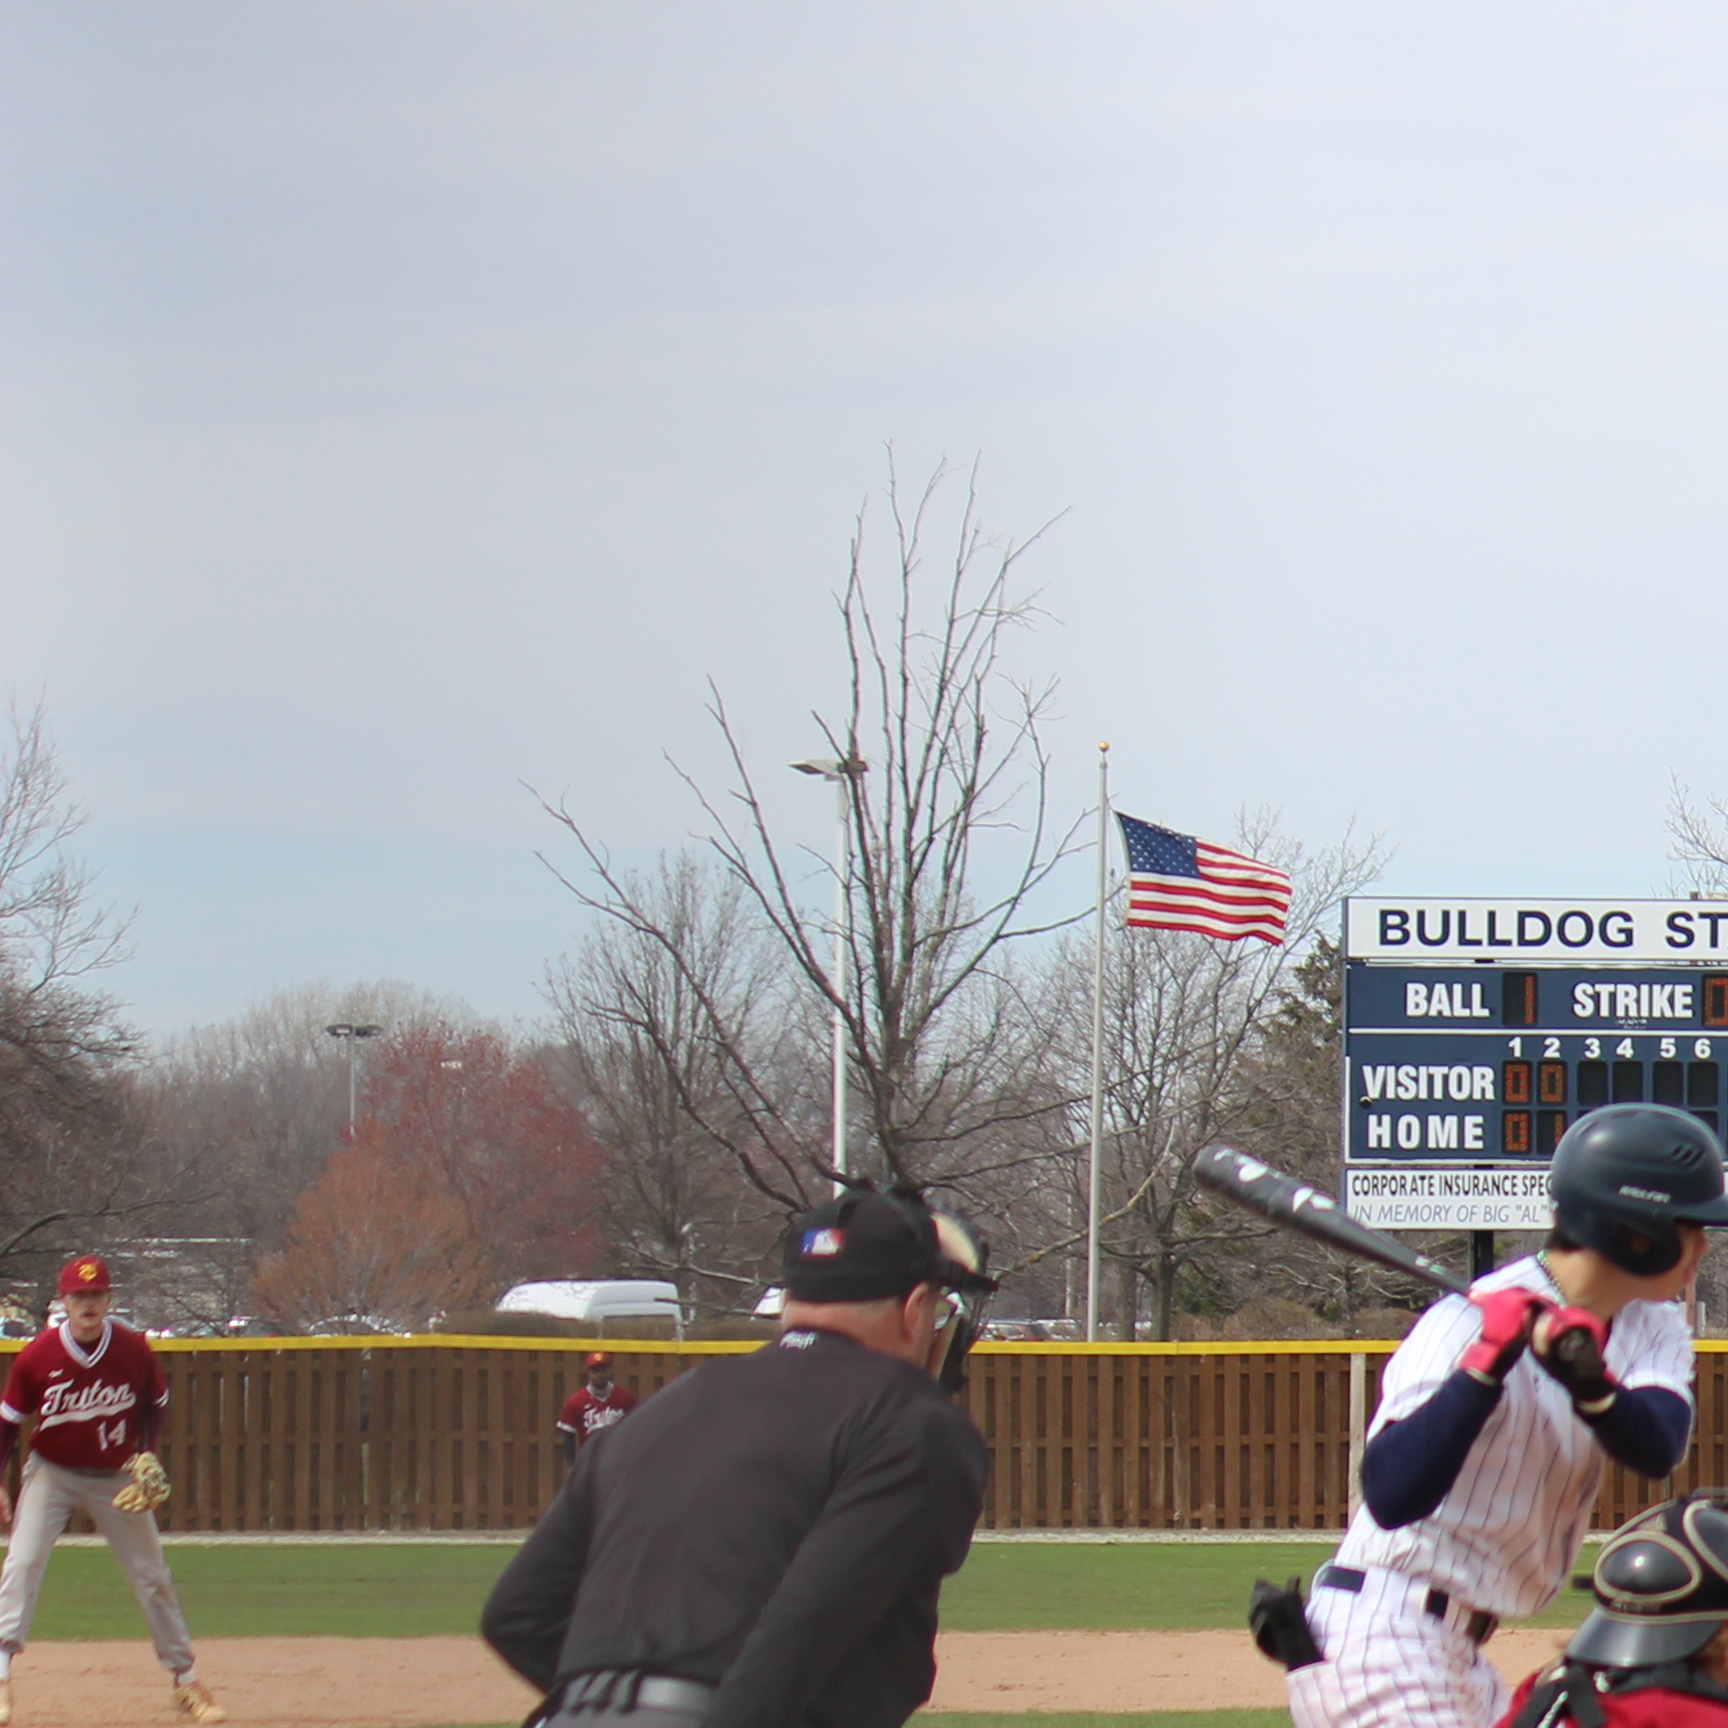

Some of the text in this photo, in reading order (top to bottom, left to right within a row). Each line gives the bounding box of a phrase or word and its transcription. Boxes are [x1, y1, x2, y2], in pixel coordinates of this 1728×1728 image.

[1379, 908, 1635, 948] BULLDOG
[1406, 982, 1490, 1017] BALL
[1573, 982, 1695, 1018] STRIKE
[1508, 1037, 1523, 1058] 1
[1543, 1037, 1561, 1058] 2
[1584, 1037, 1600, 1059] 3
[1616, 1038, 1634, 1059] 4
[1660, 1038, 1676, 1059] 5
[1694, 1038, 1711, 1059] 6
[1363, 1065, 1495, 1101] VISITOR
[1367, 1114, 1484, 1150] HOME
[1352, 1175, 1434, 1196] CORPORATE
[1439, 1175, 1517, 1196] INSURANCE
[1353, 1204, 1373, 1222] IN
[1376, 1204, 1451, 1222] MEMORY
[1456, 1204, 1479, 1223] OF
[1483, 1204, 1509, 1223] BIG
[41, 1378, 137, 1421] Triton
[97, 1419, 127, 1451] 14
